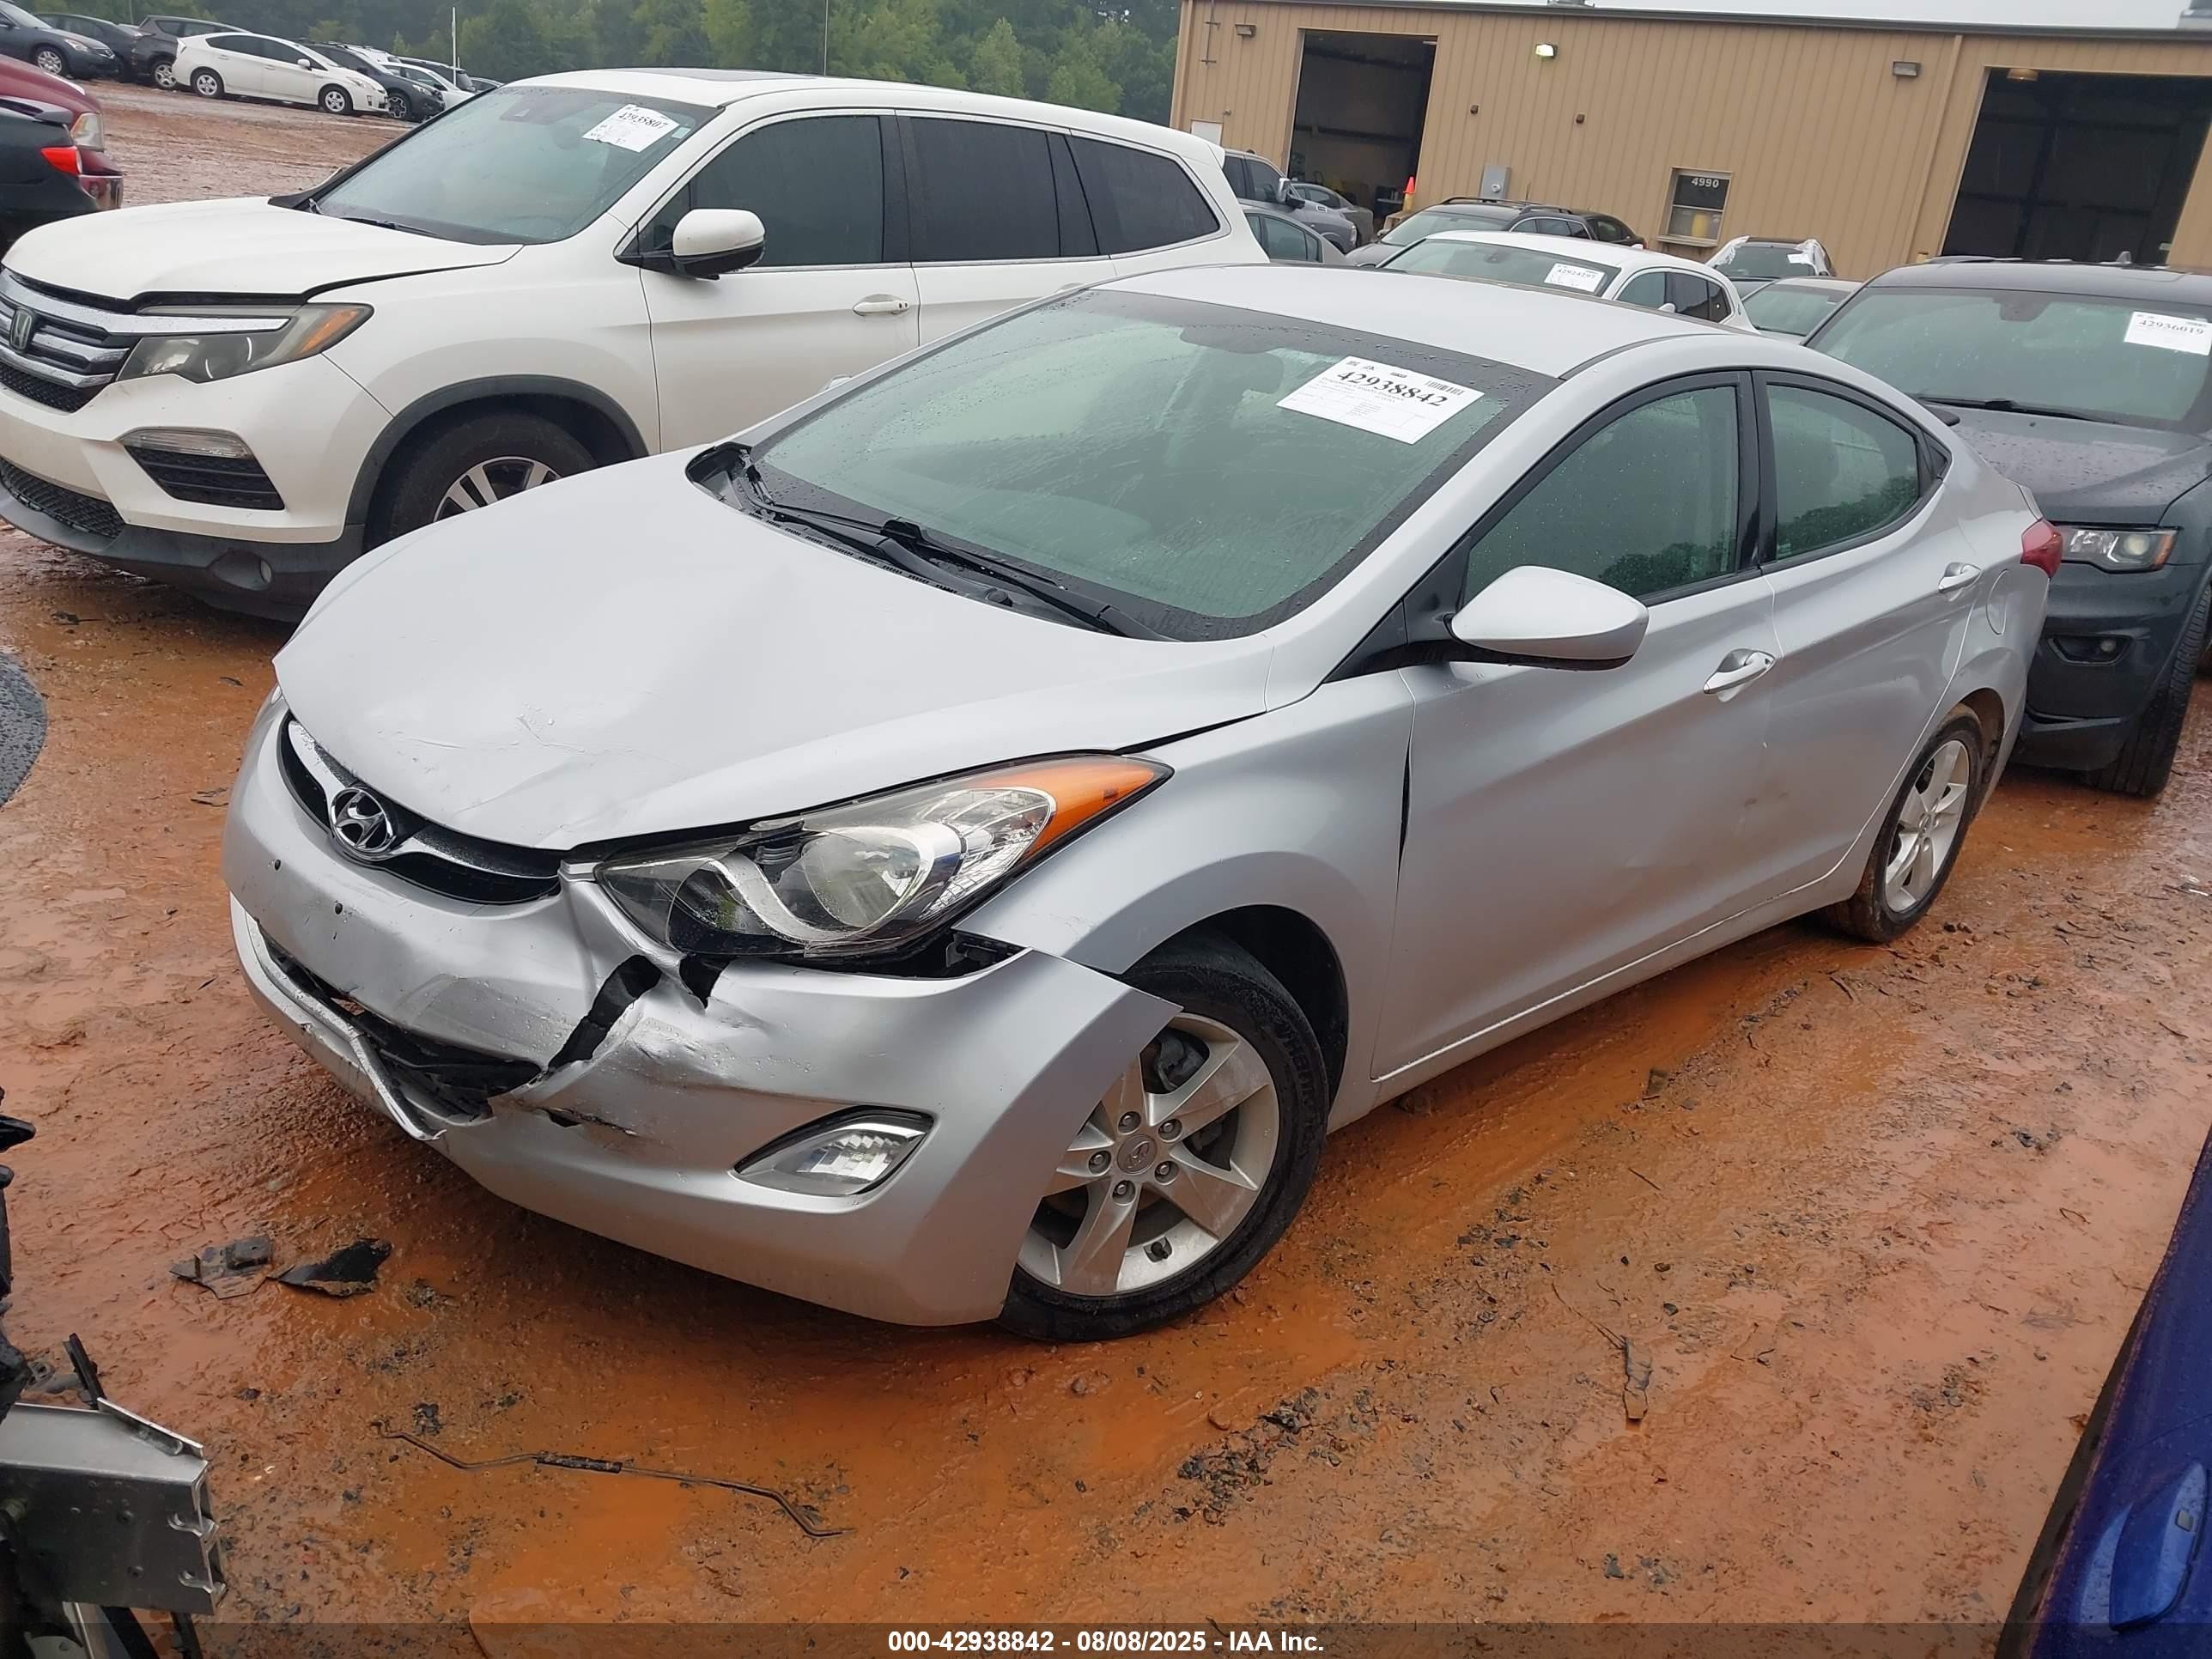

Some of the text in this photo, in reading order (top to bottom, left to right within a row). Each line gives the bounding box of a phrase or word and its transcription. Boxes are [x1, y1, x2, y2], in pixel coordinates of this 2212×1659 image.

[618, 112, 669, 130] 42935807
[1691, 177, 1720, 188] 4990
[2138, 319, 2204, 335] 42936019
[1337, 371, 1448, 406] 42938842
